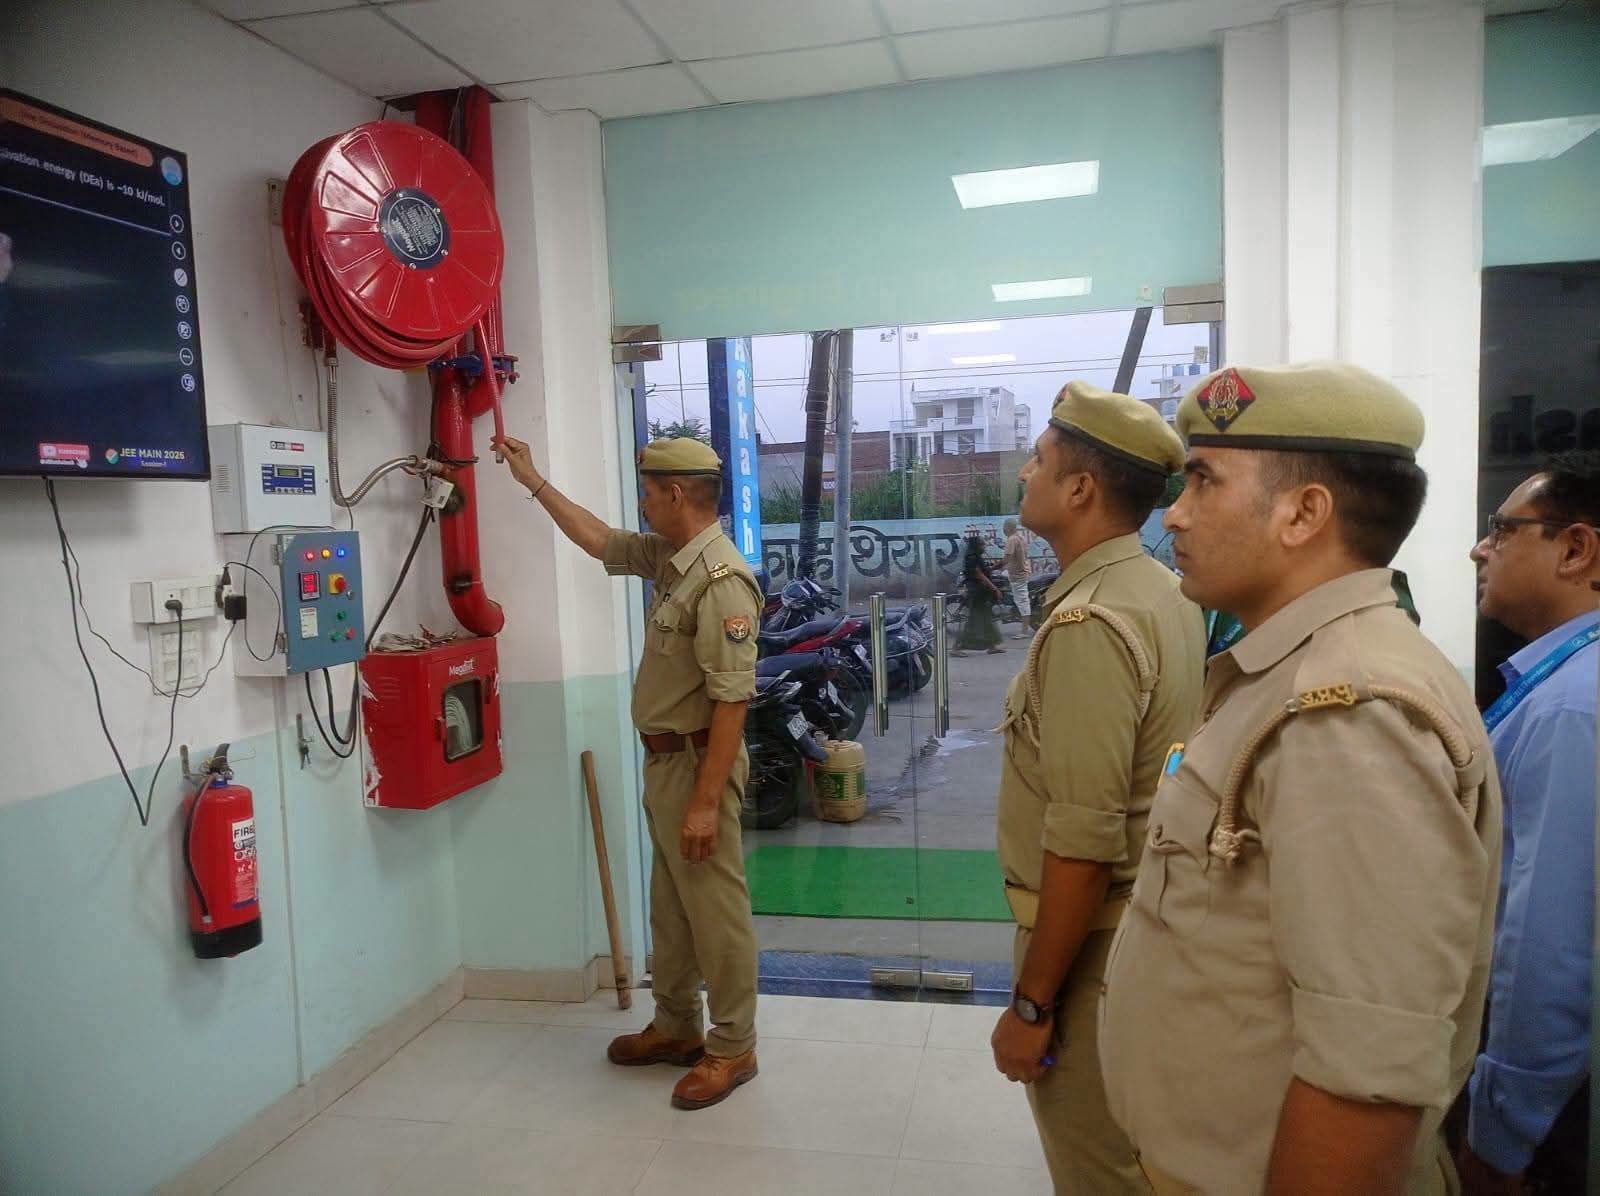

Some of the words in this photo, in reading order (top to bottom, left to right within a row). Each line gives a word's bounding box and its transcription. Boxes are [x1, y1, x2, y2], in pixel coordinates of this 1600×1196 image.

[43, 161, 76, 181] energy
[120, 447, 136, 458] JEE
[138, 448, 162, 460] MAIN
[233, 825, 256, 839] FIRE
